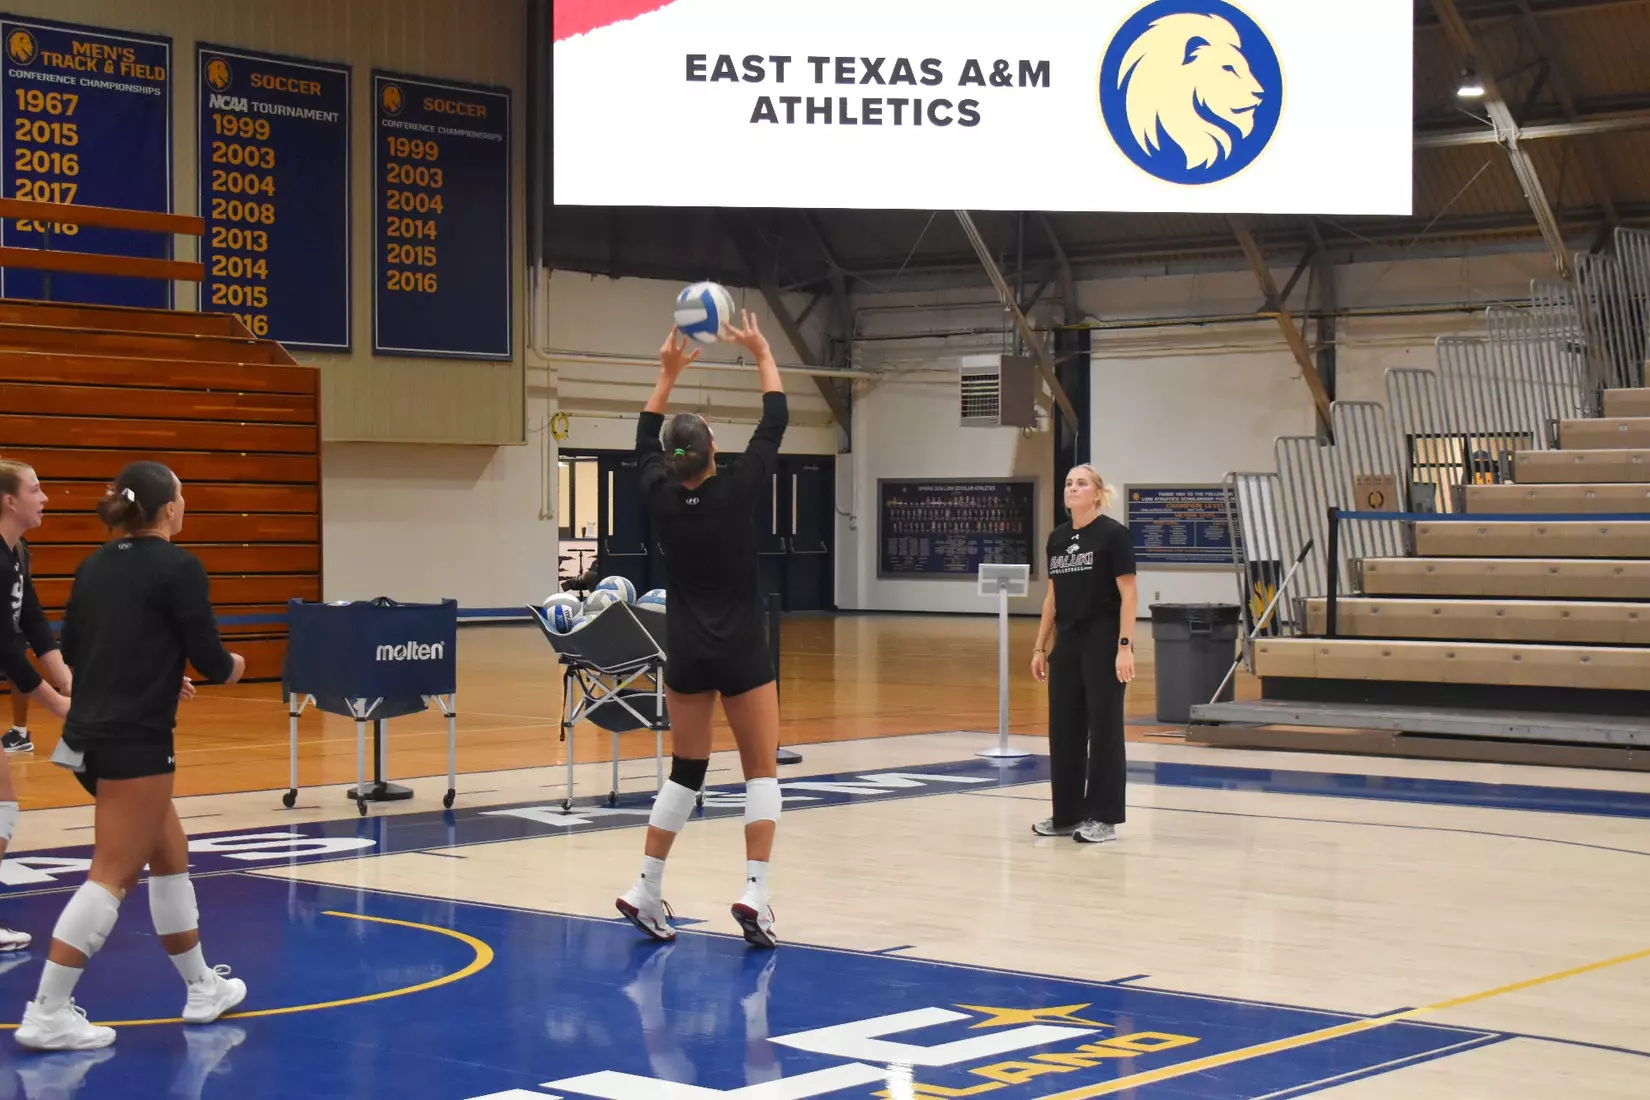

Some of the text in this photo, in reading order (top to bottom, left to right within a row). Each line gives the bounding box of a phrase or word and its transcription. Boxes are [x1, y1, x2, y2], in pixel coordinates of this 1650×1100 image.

[72, 41, 136, 63] MEN'S
[40, 51, 165, 81] TRACK & FIELD
[686, 54, 1050, 88] EAST TEXAS A&M
[8, 69, 161, 96] CONFERENCE CHAMPIONSHIPS
[250, 73, 321, 96] SOCCER
[16, 89, 78, 116] 1967
[209, 94, 339, 123] NCAA TOURNAMENT
[423, 97, 487, 118] SOCCER
[749, 95, 981, 127] ATHLETICS
[15, 118, 78, 146] 2015
[212, 113, 270, 140] 1999
[382, 119, 503, 142] CONFERENCE CHAMPIONSHIPS
[212, 141, 275, 169] 2003
[387, 136, 439, 161] 1999
[15, 148, 79, 176] 2016
[212, 170, 275, 196] 2004
[387, 162, 442, 188] 2003
[15, 178, 77, 205] 2017
[387, 189, 443, 213] 2004
[212, 198, 275, 225] 2008
[212, 227, 268, 252] 2013
[387, 216, 437, 240] 2014
[212, 255, 268, 280] 2014
[387, 243, 437, 267] 2015
[387, 270, 437, 294] 2016
[212, 284, 268, 308] 2015
[1050, 551, 1093, 570] SALUKI
[376, 641, 444, 661] molten
